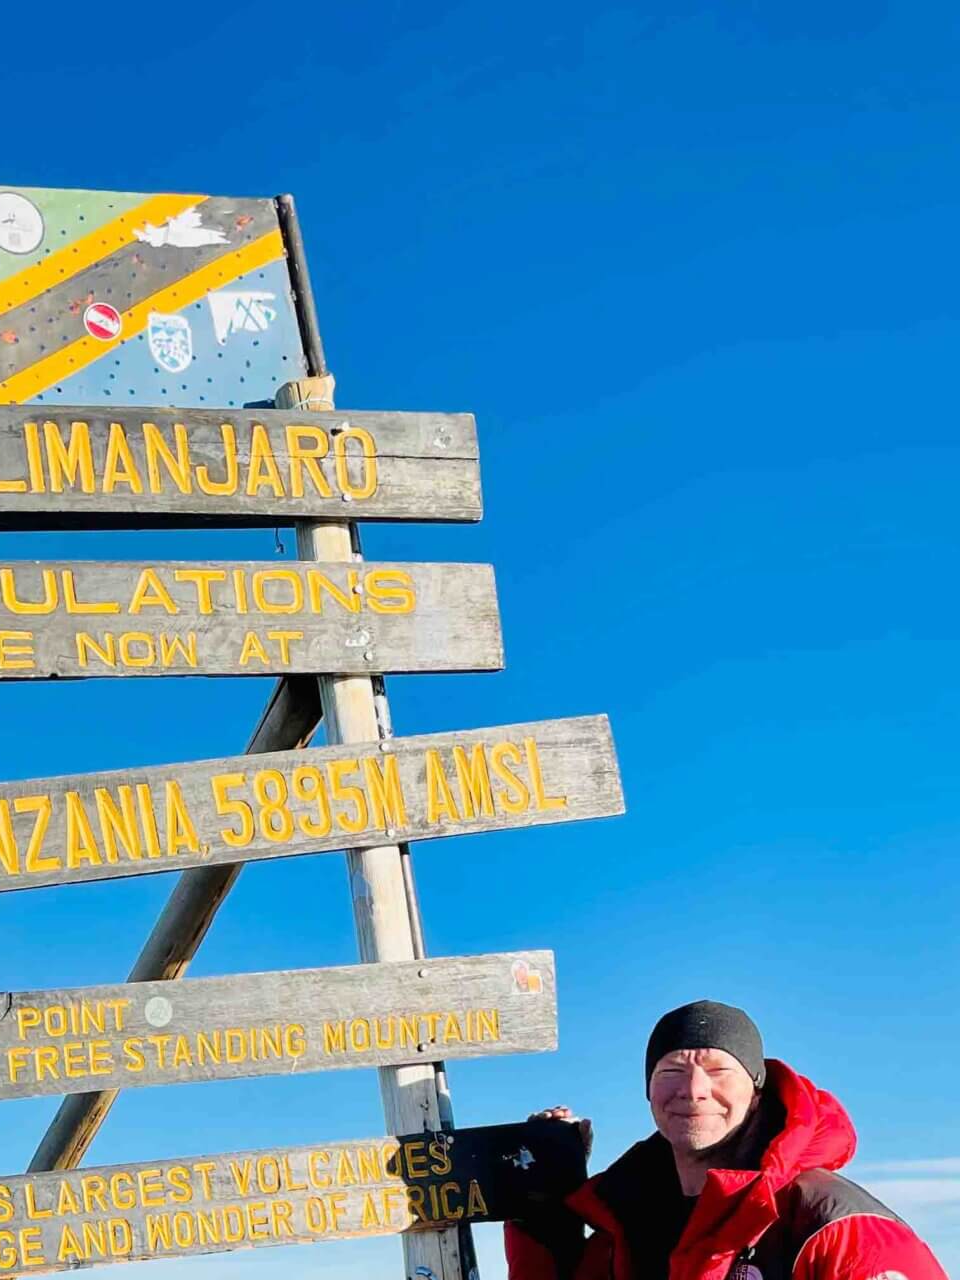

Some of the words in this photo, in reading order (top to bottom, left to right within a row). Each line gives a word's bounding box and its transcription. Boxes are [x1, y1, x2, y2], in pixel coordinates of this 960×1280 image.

[75, 630, 198, 668] NOW
[239, 630, 304, 666] AT
[210, 752, 408, 847] 5895M
[425, 736, 568, 825] AMSL
[7, 1043, 113, 1083] FREE
[122, 1022, 308, 1072] STANDING
[323, 1008, 501, 1054] MOUNTAIN
[16, 998, 130, 1040] POINT
[26, 1161, 215, 1220] LARGEST
[229, 1141, 451, 1196] VOLCANOES
[57, 1217, 133, 1262] AND
[146, 1201, 295, 1251] WONDER
[304, 1194, 348, 1233] OF
[360, 1179, 489, 1229] AFRICA
